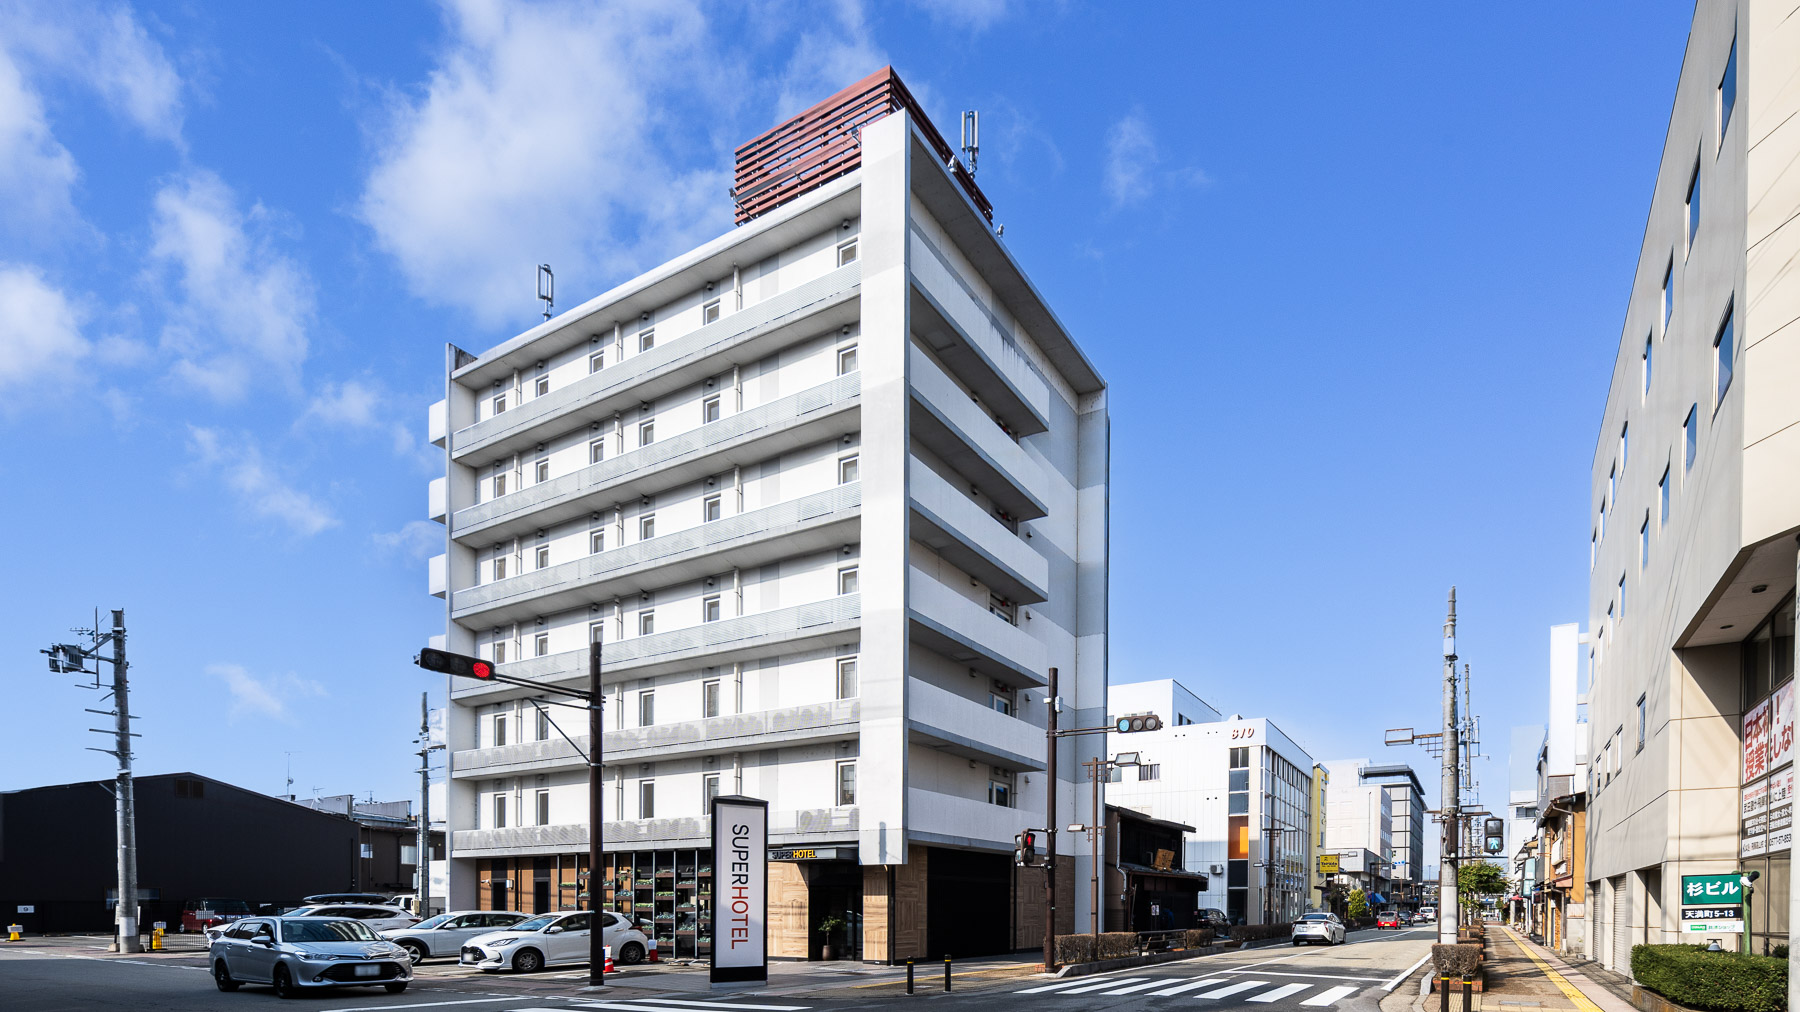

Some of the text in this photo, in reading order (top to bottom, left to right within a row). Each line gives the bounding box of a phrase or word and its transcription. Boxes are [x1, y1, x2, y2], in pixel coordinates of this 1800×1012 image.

[772, 850, 816, 860] SUPERHOTEL
[731, 824, 749, 950] SUPERHOTEL
[1686, 881, 1740, 896] 杉ビル
